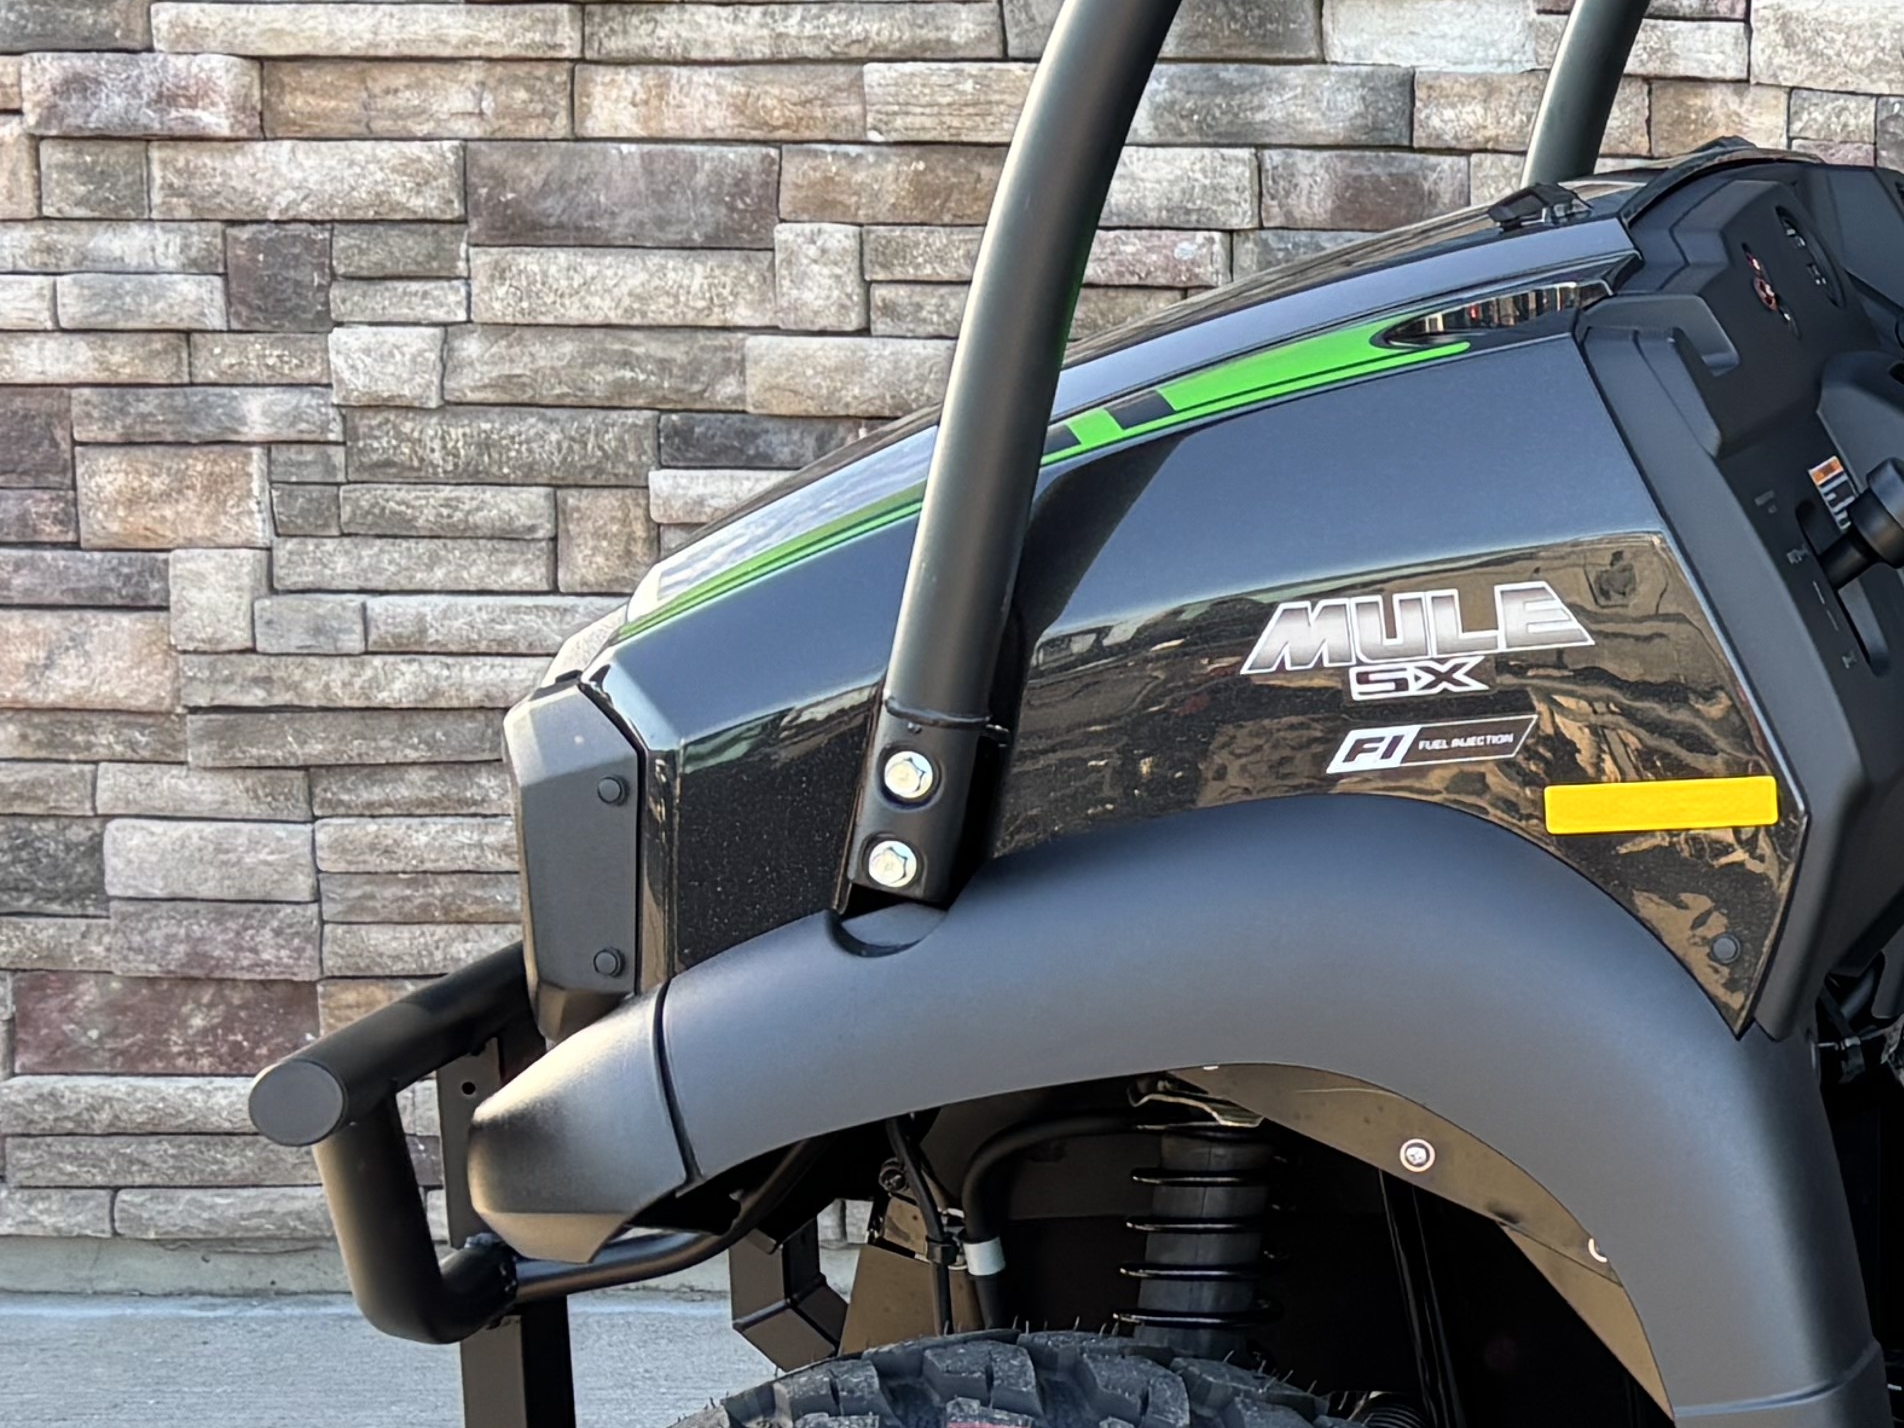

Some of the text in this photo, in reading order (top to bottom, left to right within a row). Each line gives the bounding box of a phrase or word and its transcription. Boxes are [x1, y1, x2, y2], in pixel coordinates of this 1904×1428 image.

[1240, 581, 1595, 675] MULE
[1349, 656, 1490, 701] SX
[1342, 734, 1406, 764] FI
[1418, 739, 1449, 751] FUEL
